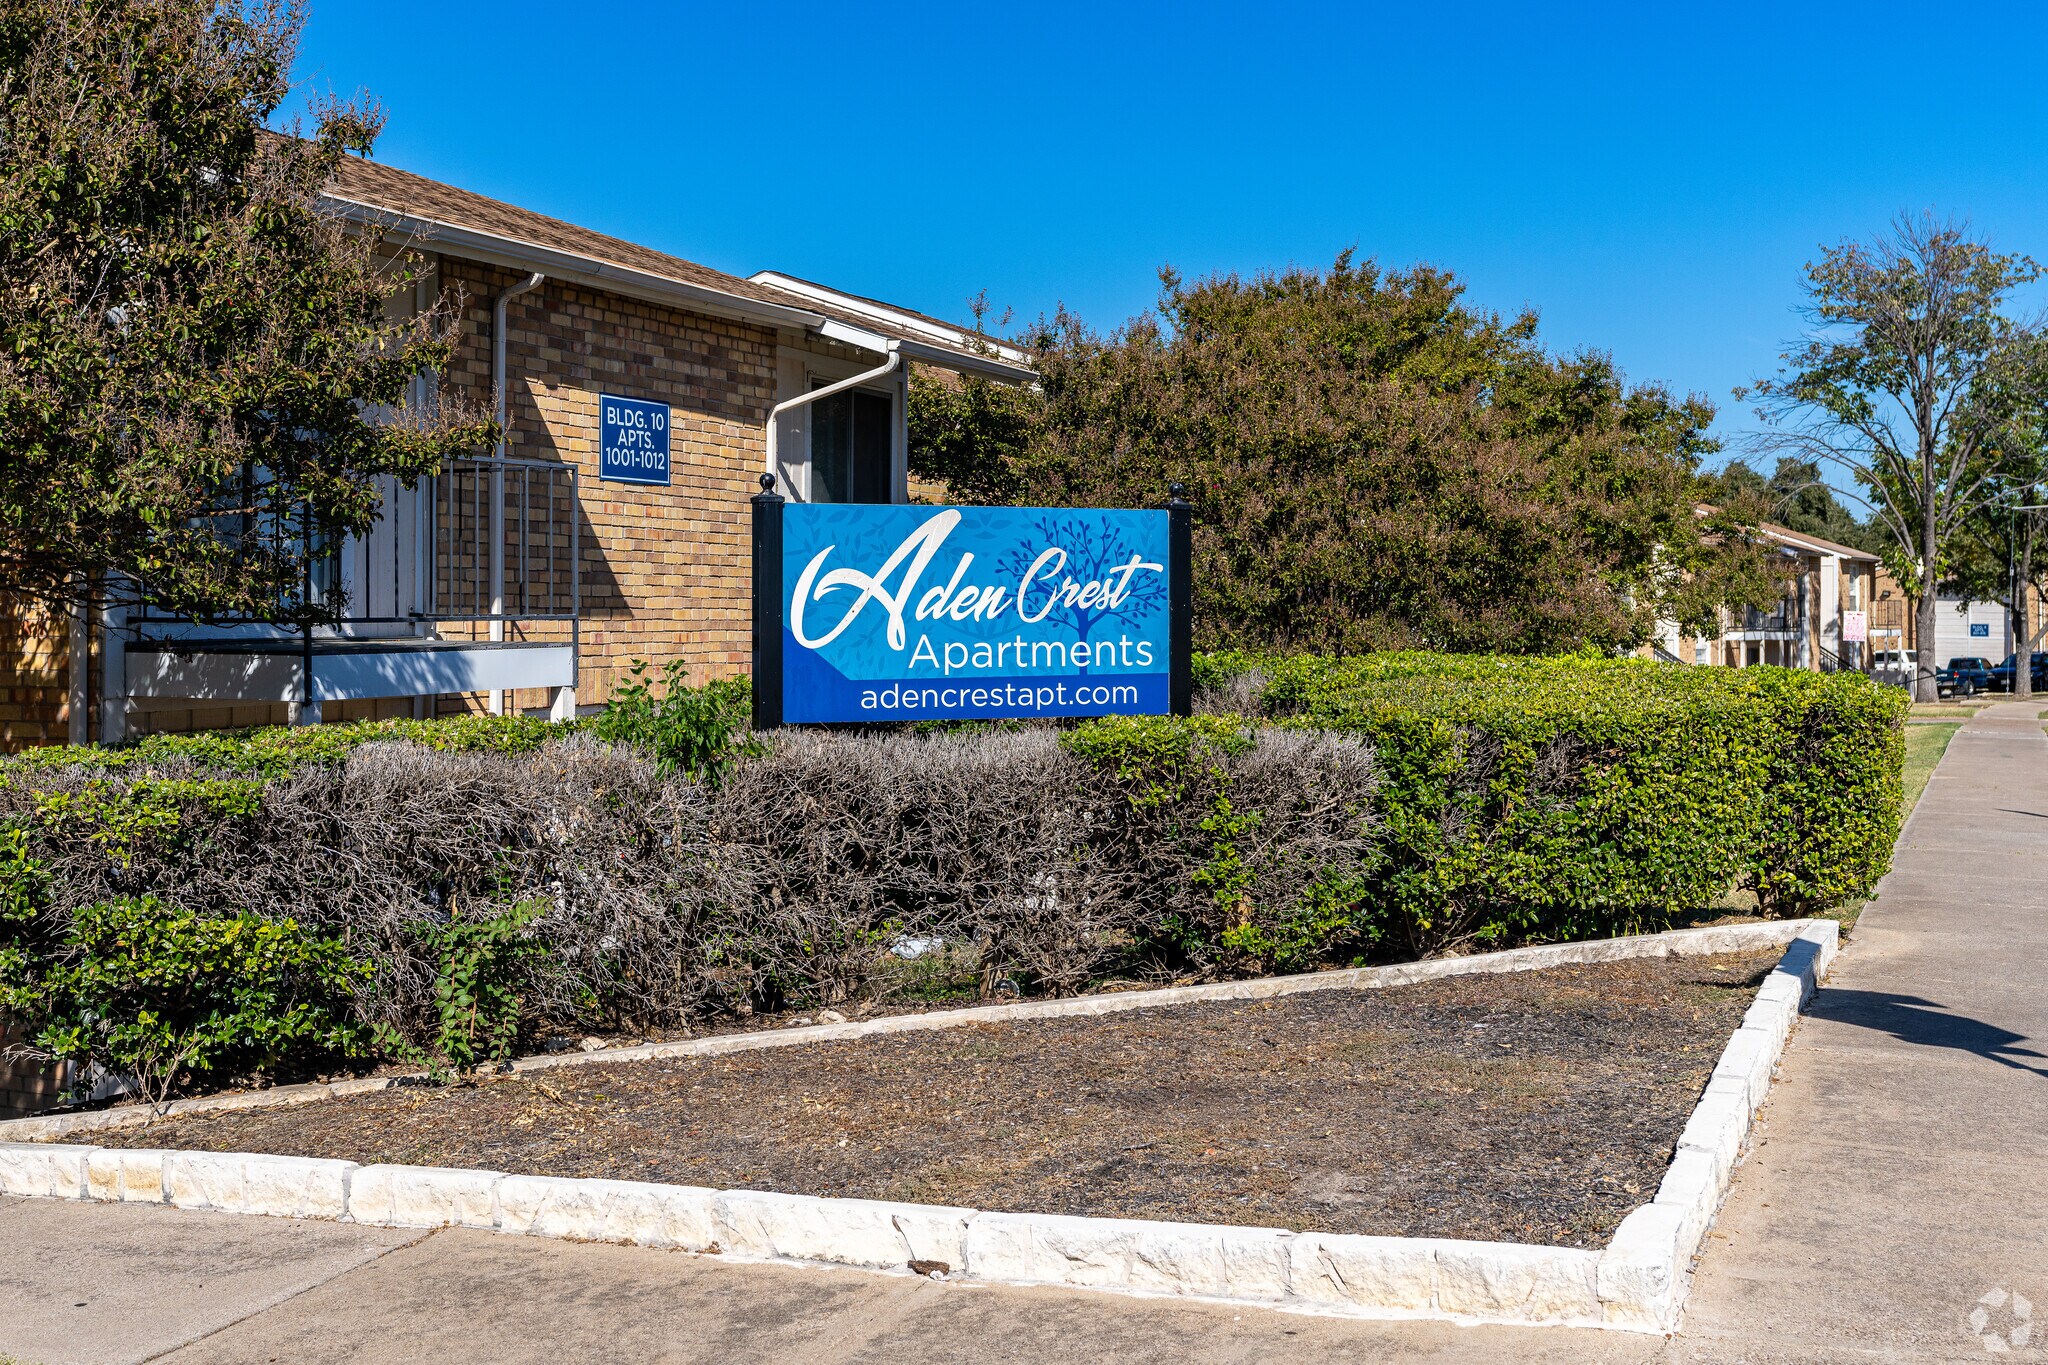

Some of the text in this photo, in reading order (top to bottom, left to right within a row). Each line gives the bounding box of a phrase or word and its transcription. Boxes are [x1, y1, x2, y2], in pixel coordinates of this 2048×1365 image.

[607, 406, 664, 431] BLDG. 10
[617, 428, 655, 449] APTS.
[605, 447, 665, 470] 1001-1012
[791, 509, 1164, 651] Aden Crest
[909, 634, 1153, 676] Apartments
[861, 683, 1138, 710] adencrestapt.com
